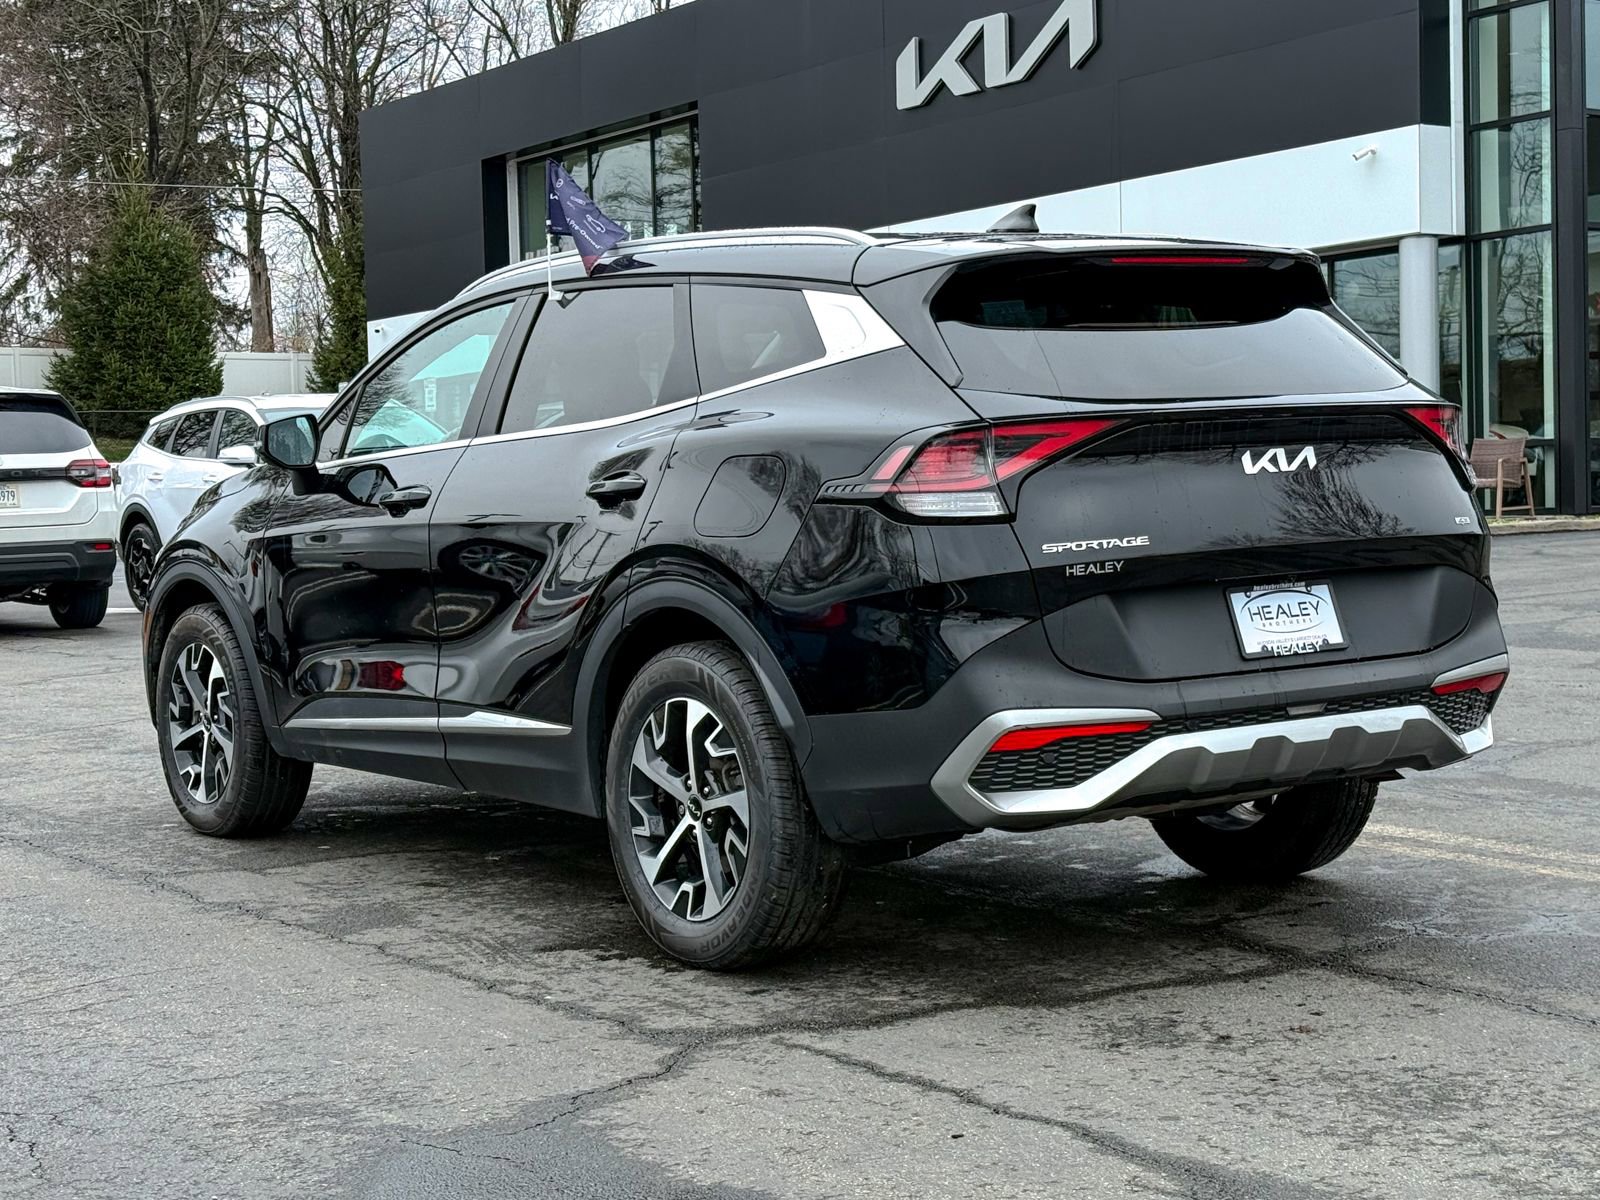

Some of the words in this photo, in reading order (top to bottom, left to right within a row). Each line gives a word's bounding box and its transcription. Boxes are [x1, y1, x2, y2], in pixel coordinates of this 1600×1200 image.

[896, 0, 1098, 110] KIA
[1241, 446, 1317, 475] KIA
[1042, 535, 1150, 554] SPORTAGE
[1066, 560, 1124, 577] HEALEY
[1247, 600, 1320, 622] HEALEY
[1261, 617, 1313, 628] BROTHERS
[1272, 640, 1321, 656] HEALEY
